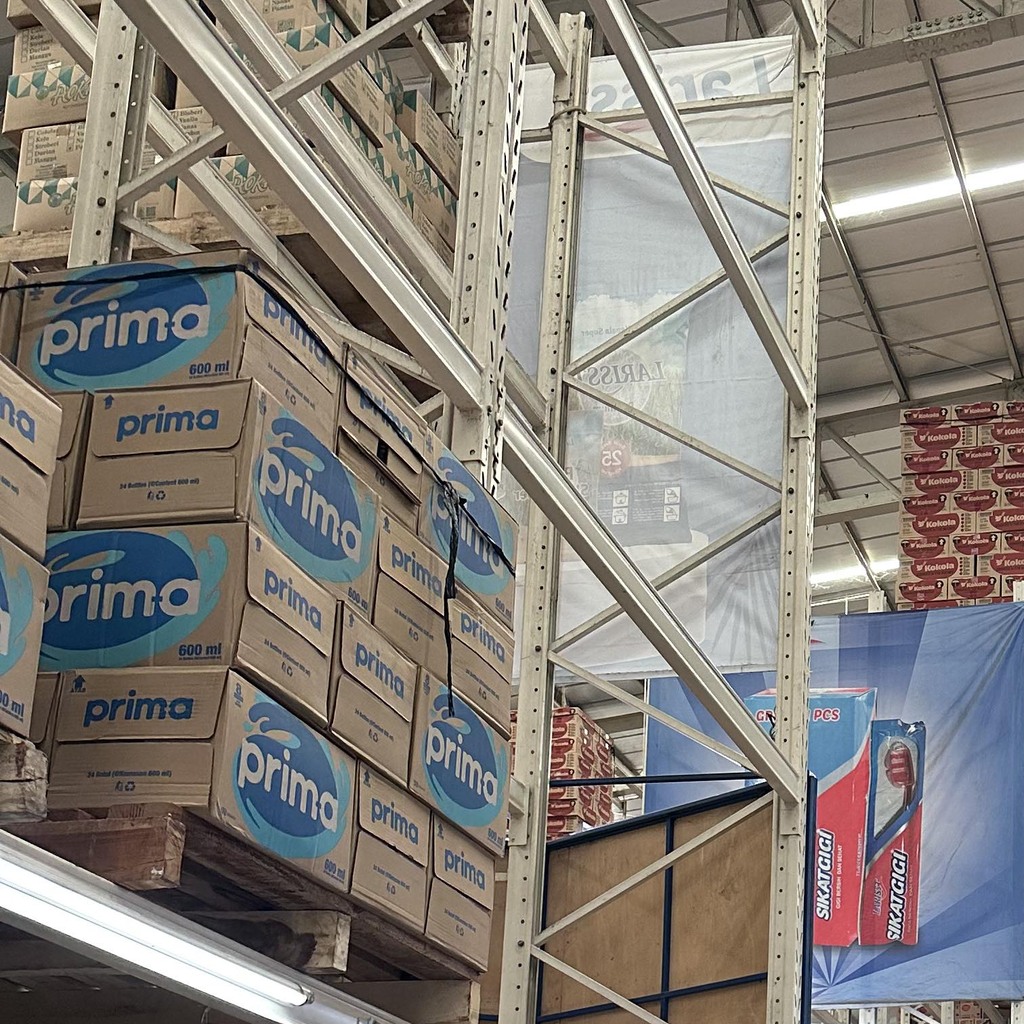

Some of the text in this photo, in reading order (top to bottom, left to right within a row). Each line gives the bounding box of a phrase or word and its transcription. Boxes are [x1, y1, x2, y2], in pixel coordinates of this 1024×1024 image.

[39, 300, 210, 365] prima
[189, 361, 229, 376] 600 ml
[116, 405, 219, 442] prima
[928, 432, 958, 442] Kokola
[929, 476, 958, 486] Kokola
[259, 450, 362, 562] prima
[926, 518, 956, 529] Kokola
[391, 544, 442, 598] prima
[925, 562, 955, 572] Kokola
[264, 568, 322, 632] prima
[179, 643, 221, 657] 600 ml
[460, 612, 505, 663] prima
[355, 641, 405, 699] prima
[83, 689, 194, 727] prima
[813, 709, 840, 721] PCS
[238, 738, 338, 832] prima
[426, 724, 498, 806] prima
[371, 797, 419, 845] prima
[444, 848, 485, 891] prima
[816, 829, 835, 921] SIKATGIGI
[887, 849, 908, 941] SIKATGIGI
